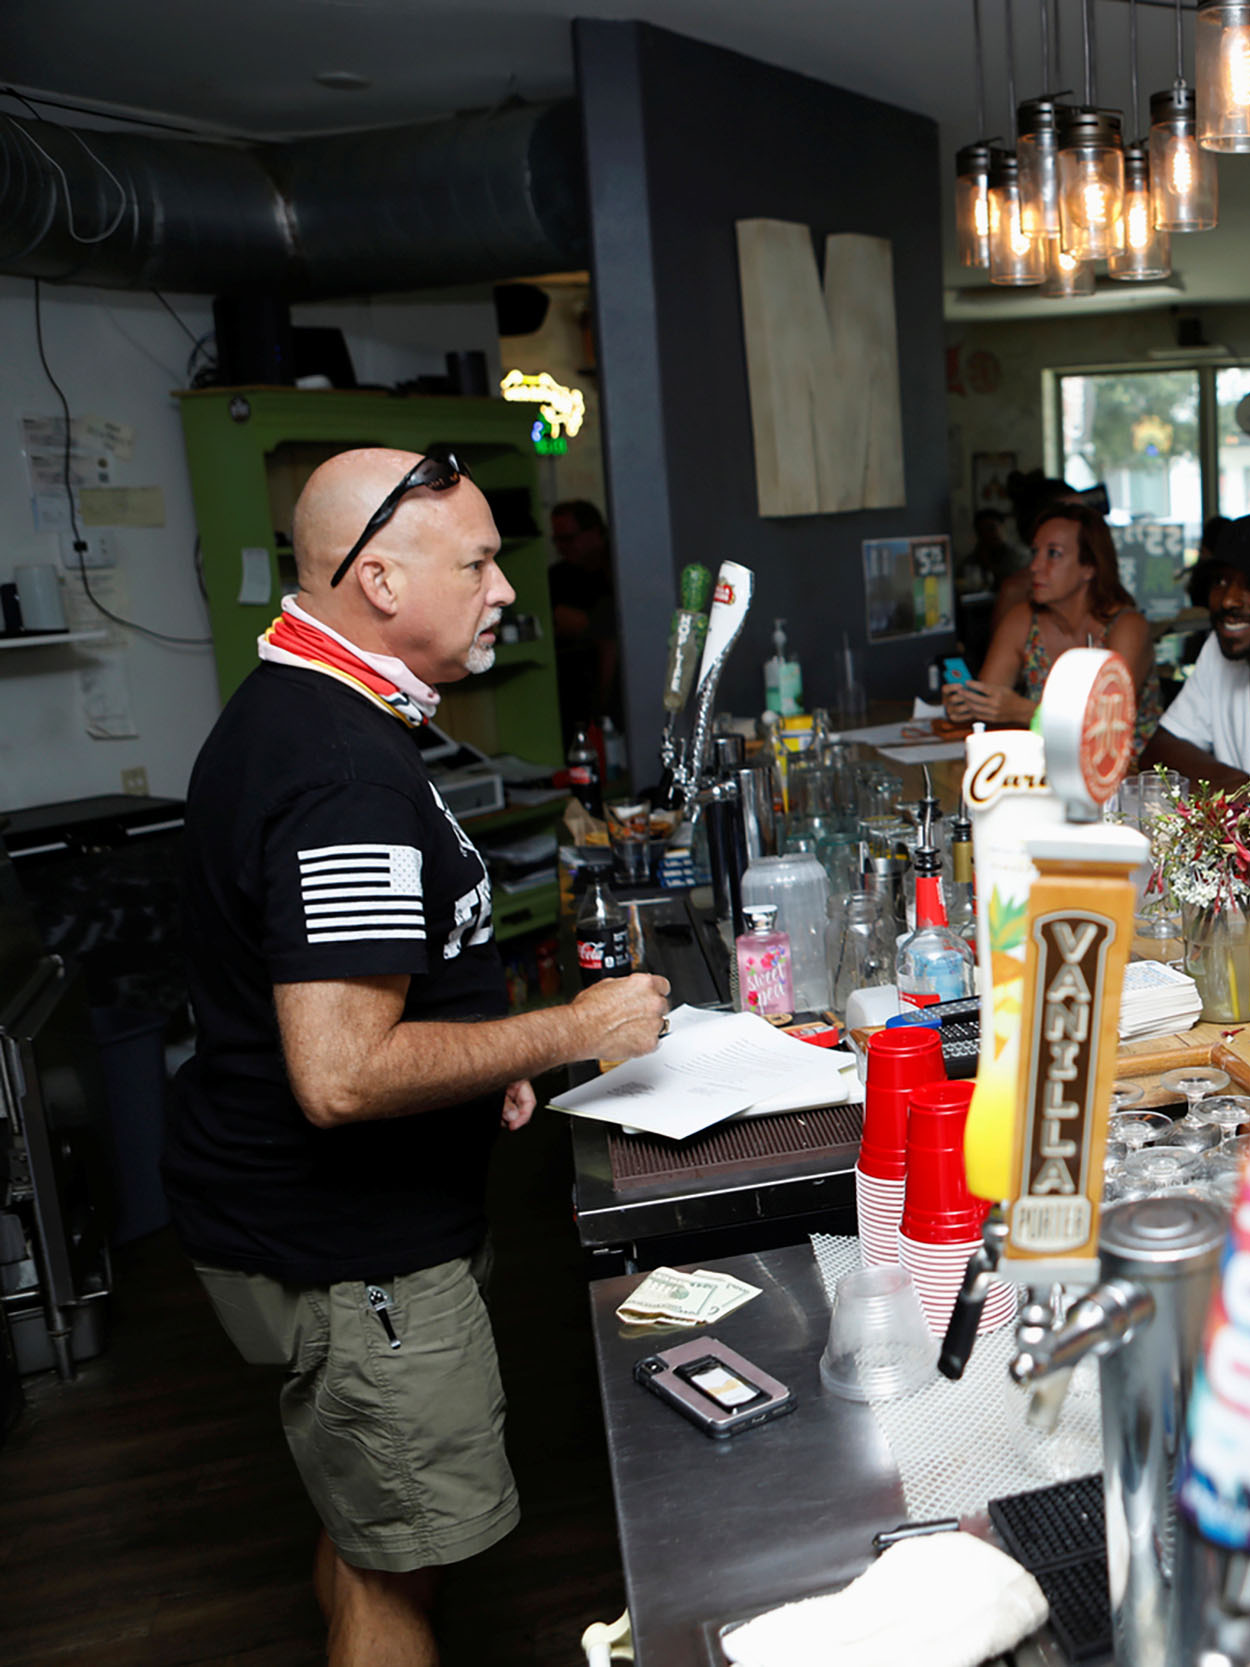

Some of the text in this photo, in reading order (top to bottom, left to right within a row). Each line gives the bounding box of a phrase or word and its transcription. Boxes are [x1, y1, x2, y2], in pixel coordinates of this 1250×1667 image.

[746, 962, 785, 990] sweet
[757, 983, 785, 1015] pea
[1030, 920, 1098, 1196] VANILLA
